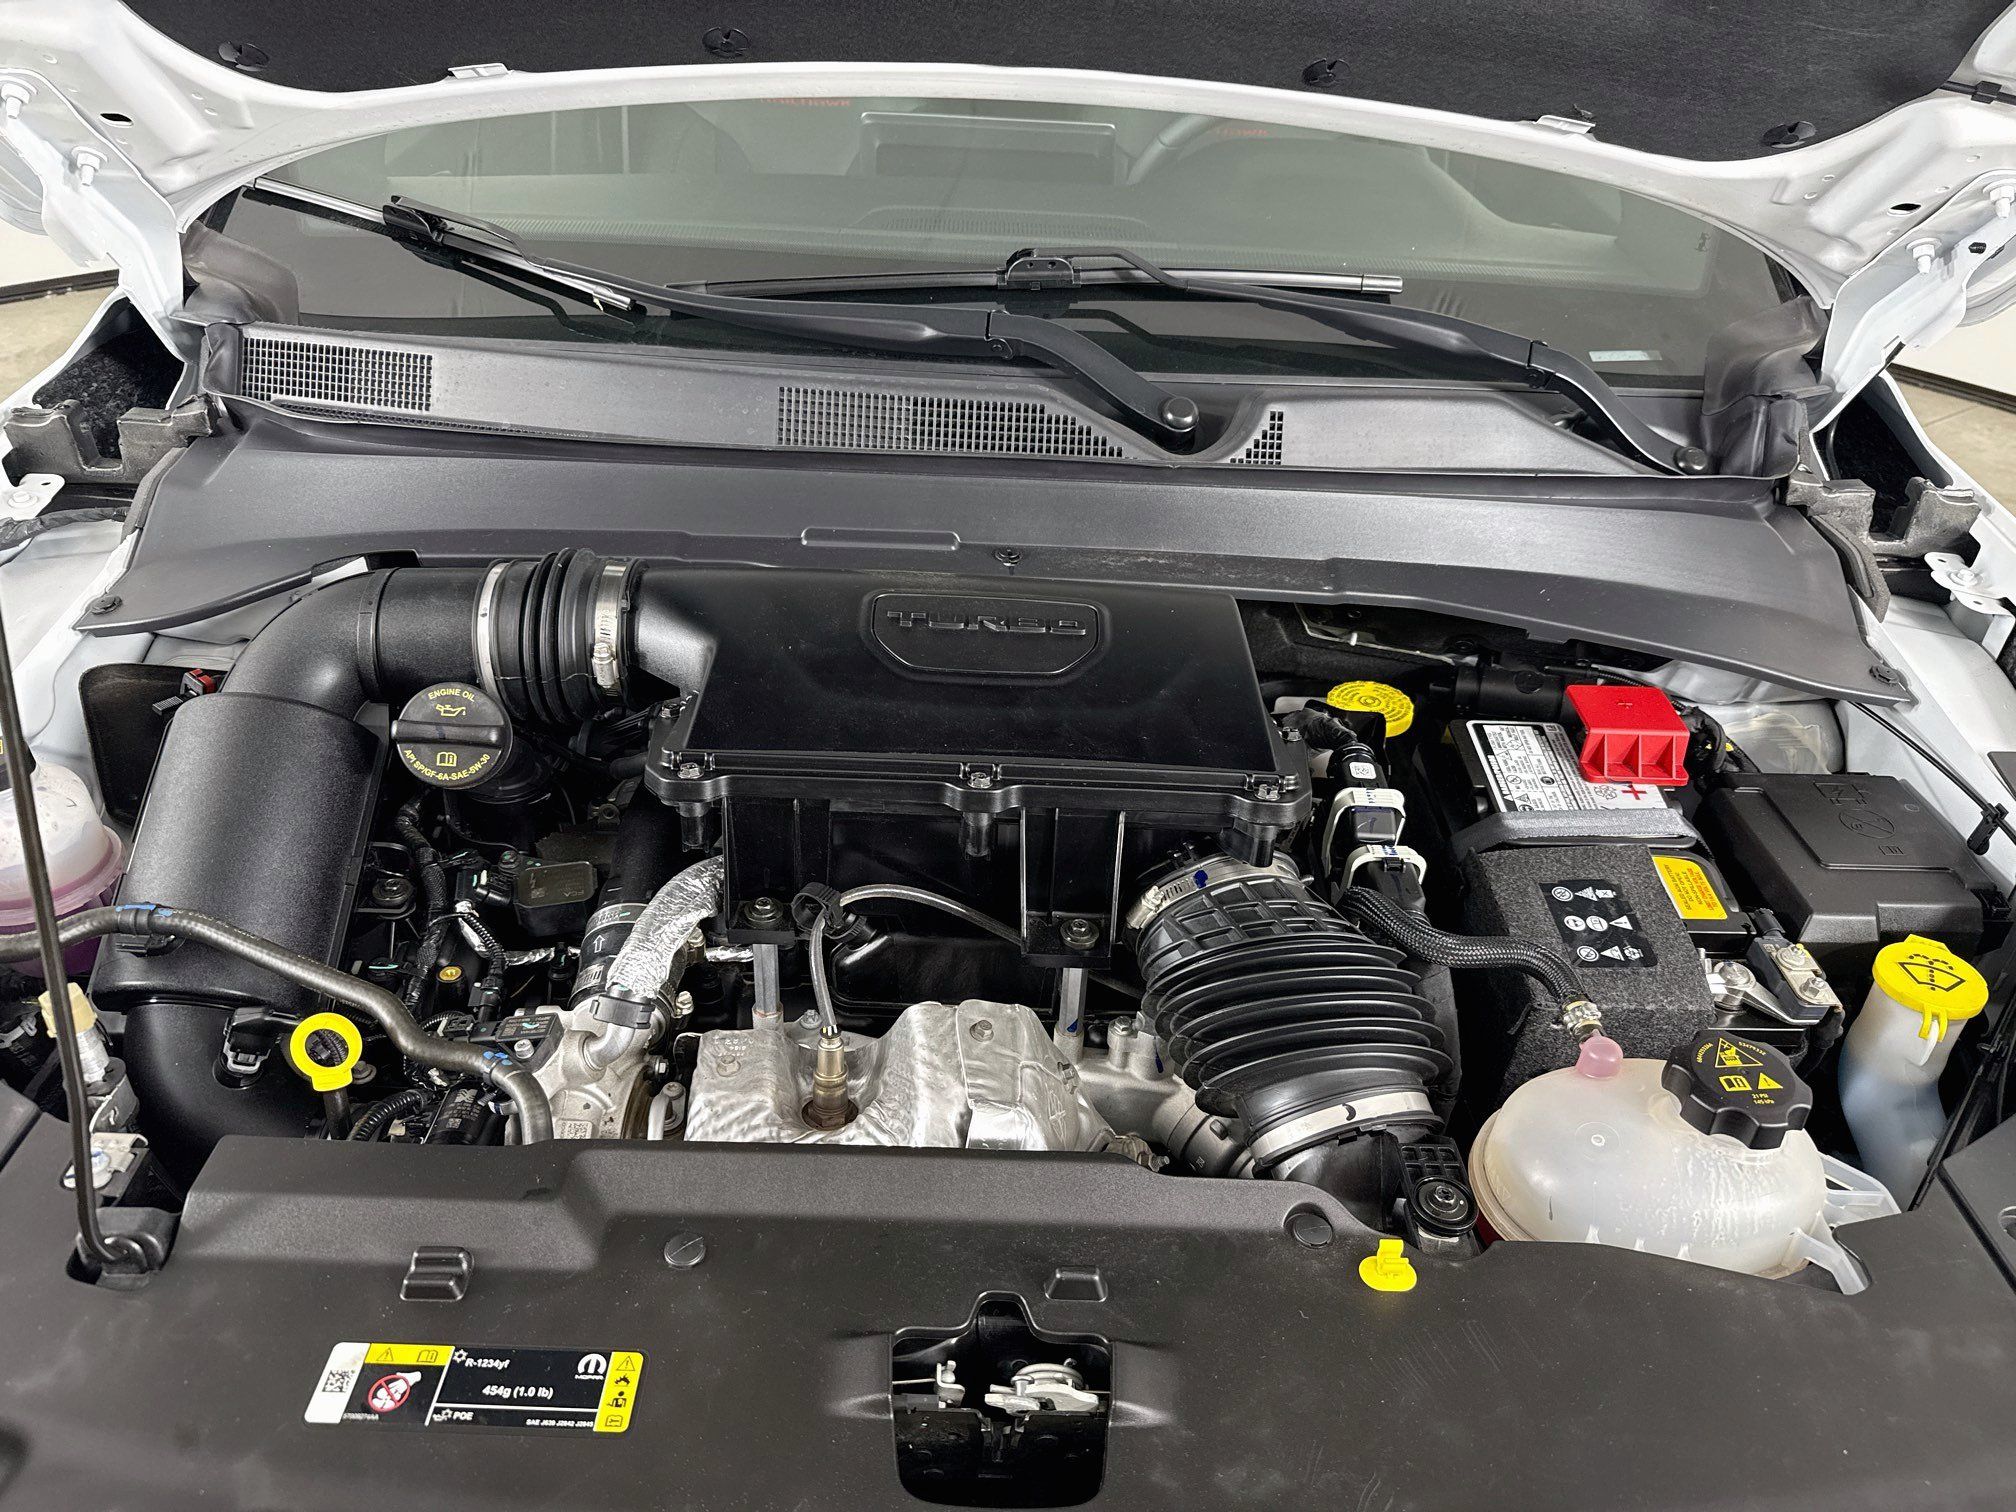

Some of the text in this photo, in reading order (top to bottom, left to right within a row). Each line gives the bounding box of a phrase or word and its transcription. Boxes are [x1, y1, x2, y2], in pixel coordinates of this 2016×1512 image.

[887, 611, 1086, 635] TURBO
[428, 688, 476, 702] ENGINE OIL
[404, 749, 417, 763] API
[563, 889, 585, 897] FCA
[464, 1358, 511, 1370] R-1234yf
[482, 1385, 554, 1400] 454g (1.0 lb)
[452, 1411, 474, 1421] POE
